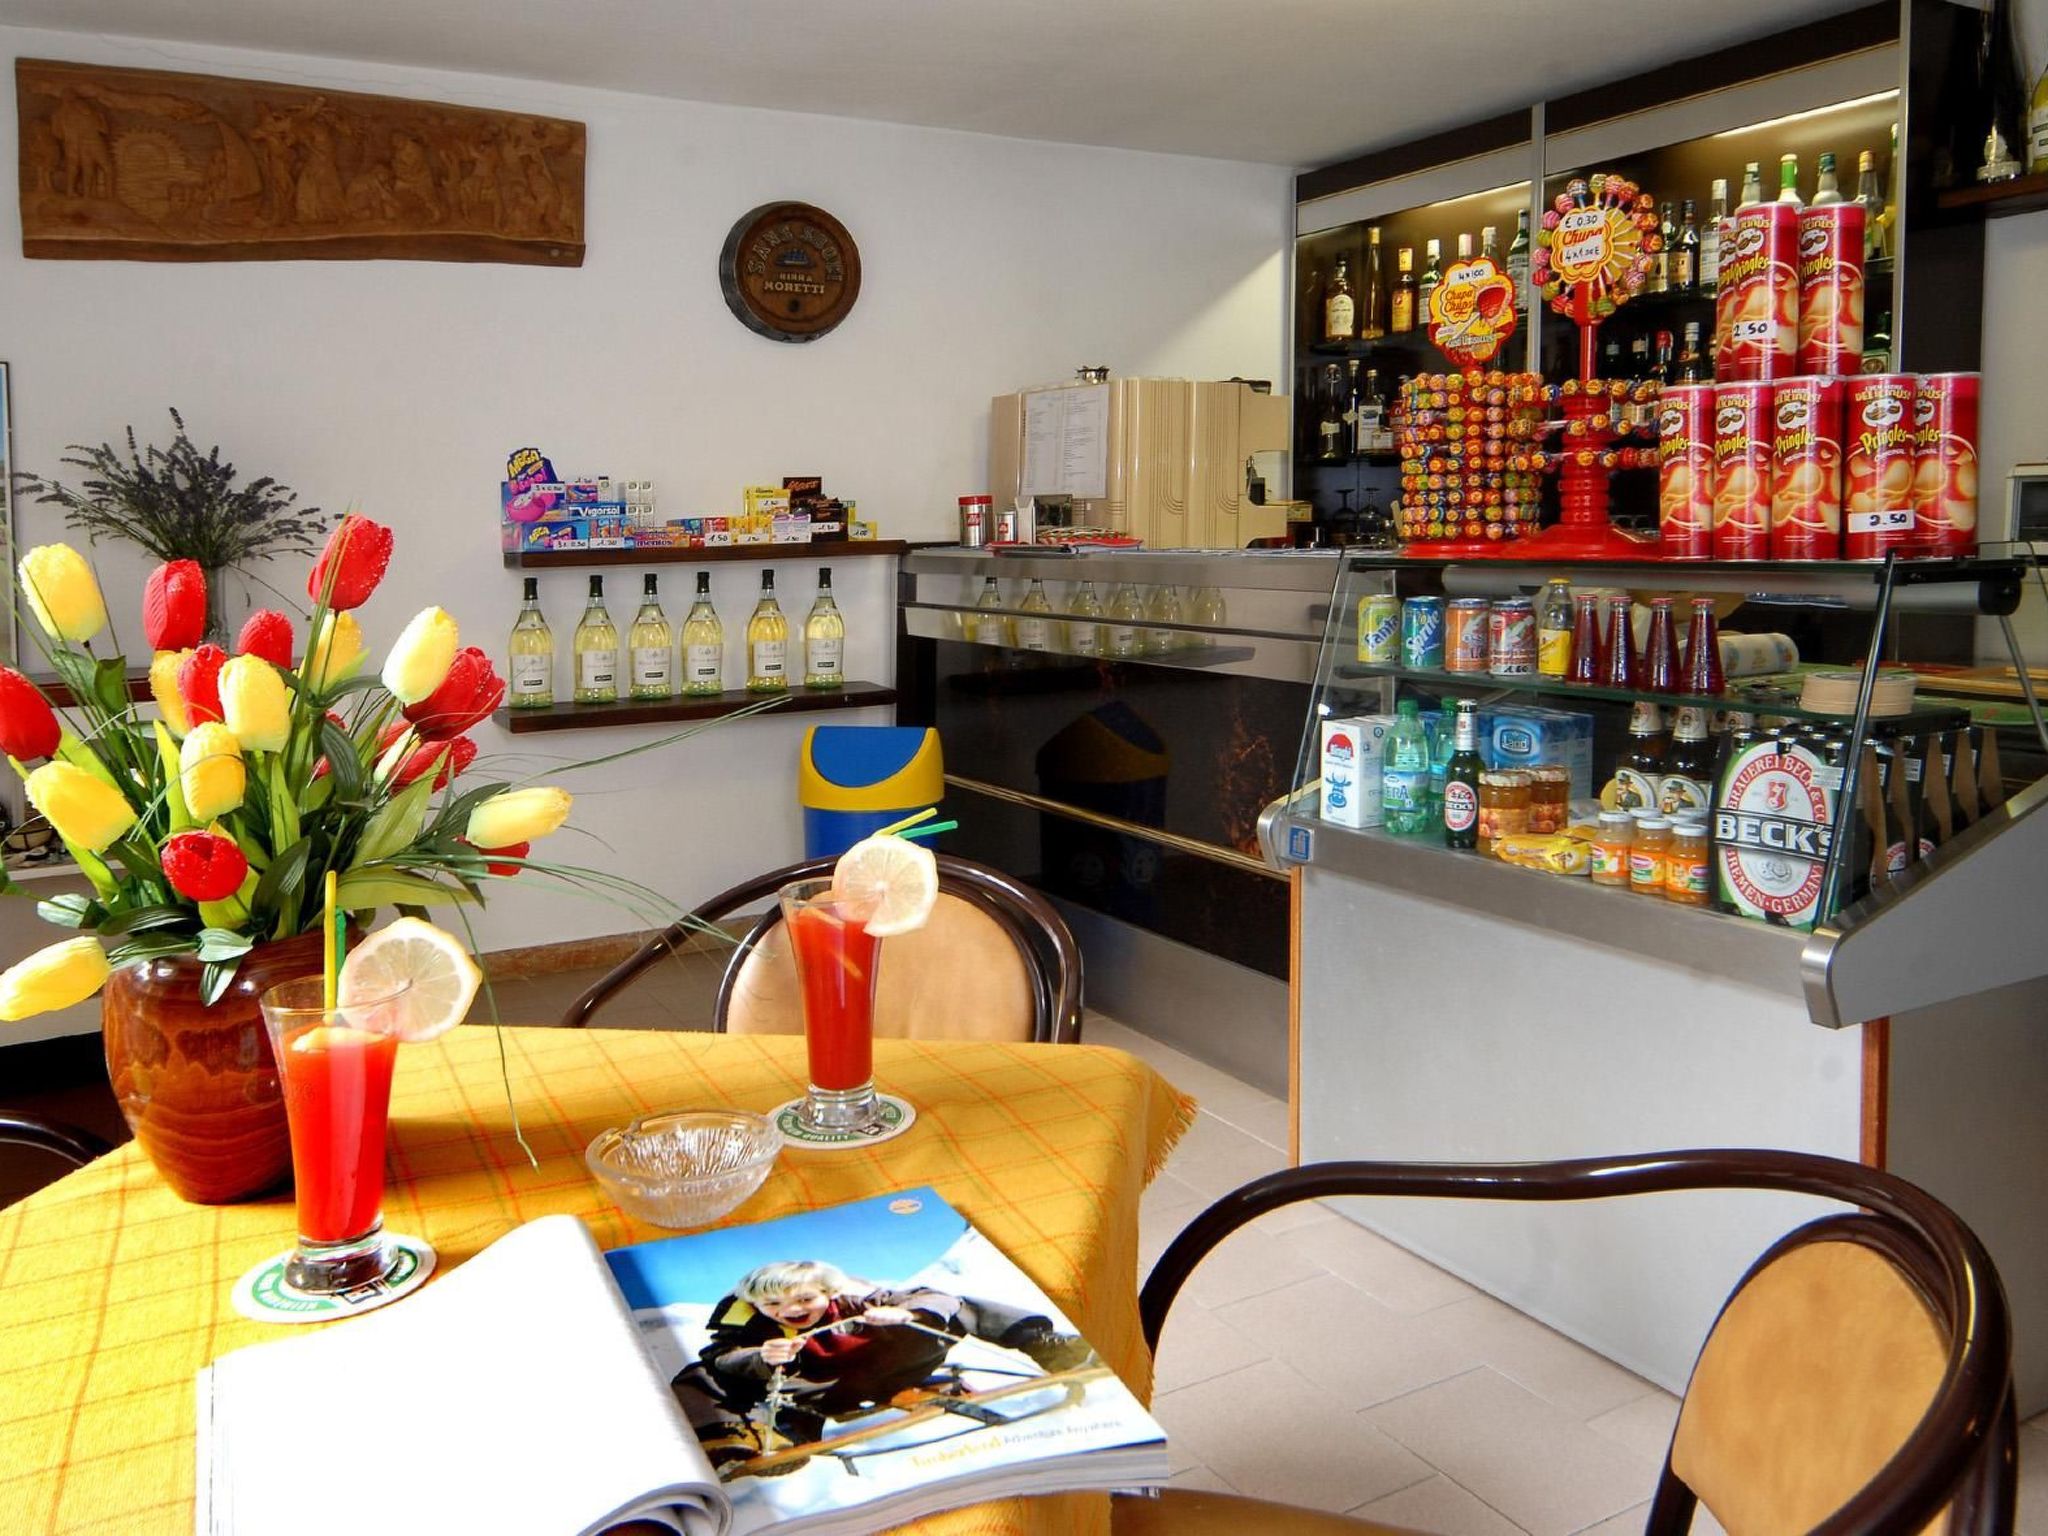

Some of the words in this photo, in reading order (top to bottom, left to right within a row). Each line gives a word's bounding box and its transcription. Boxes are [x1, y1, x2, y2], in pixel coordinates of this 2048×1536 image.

[1577, 215, 1597, 226] 0.30
[764, 281, 825, 294] MORETTI
[1446, 290, 1473, 301] Chupa
[1445, 301, 1474, 313] Chups
[1776, 427, 1816, 457] Pringles
[1860, 424, 1907, 455] Pringles
[508, 449, 541, 478] MEGA
[579, 505, 620, 517] Vigorsol
[1869, 513, 1907, 526] 2.50
[1364, 614, 1398, 650] Fanta
[1728, 755, 1780, 810] BRAUEREI
[1715, 813, 1832, 857] BECK'S
